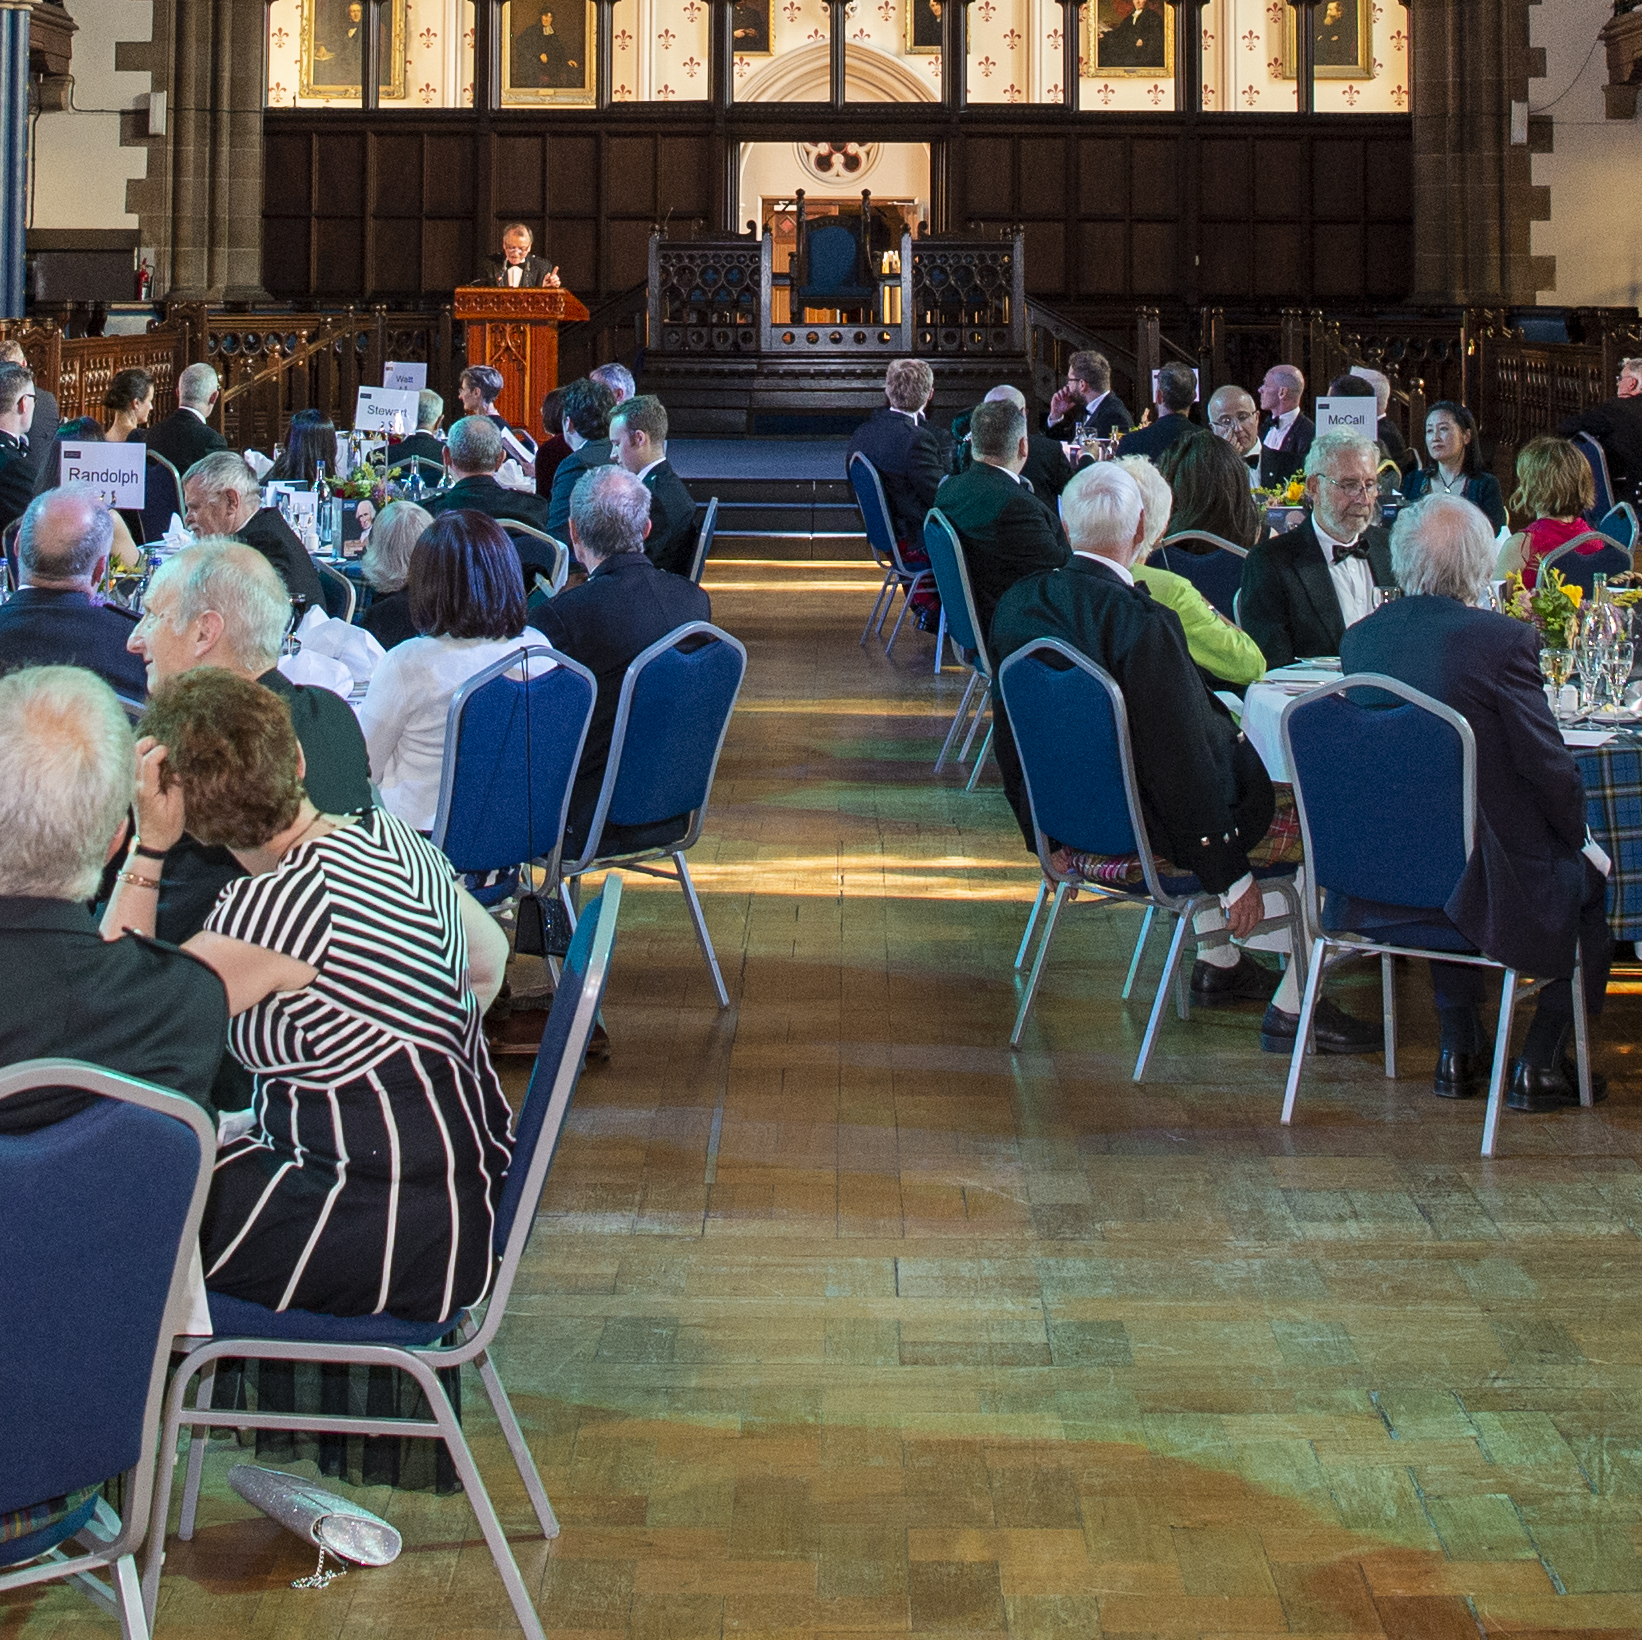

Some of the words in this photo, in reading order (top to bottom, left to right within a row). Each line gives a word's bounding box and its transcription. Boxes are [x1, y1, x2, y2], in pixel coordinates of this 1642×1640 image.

[396, 374, 414, 384] Watt
[366, 403, 408, 418] Stewart
[1328, 414, 1365, 425] McCall
[68, 466, 139, 487] Randolph
